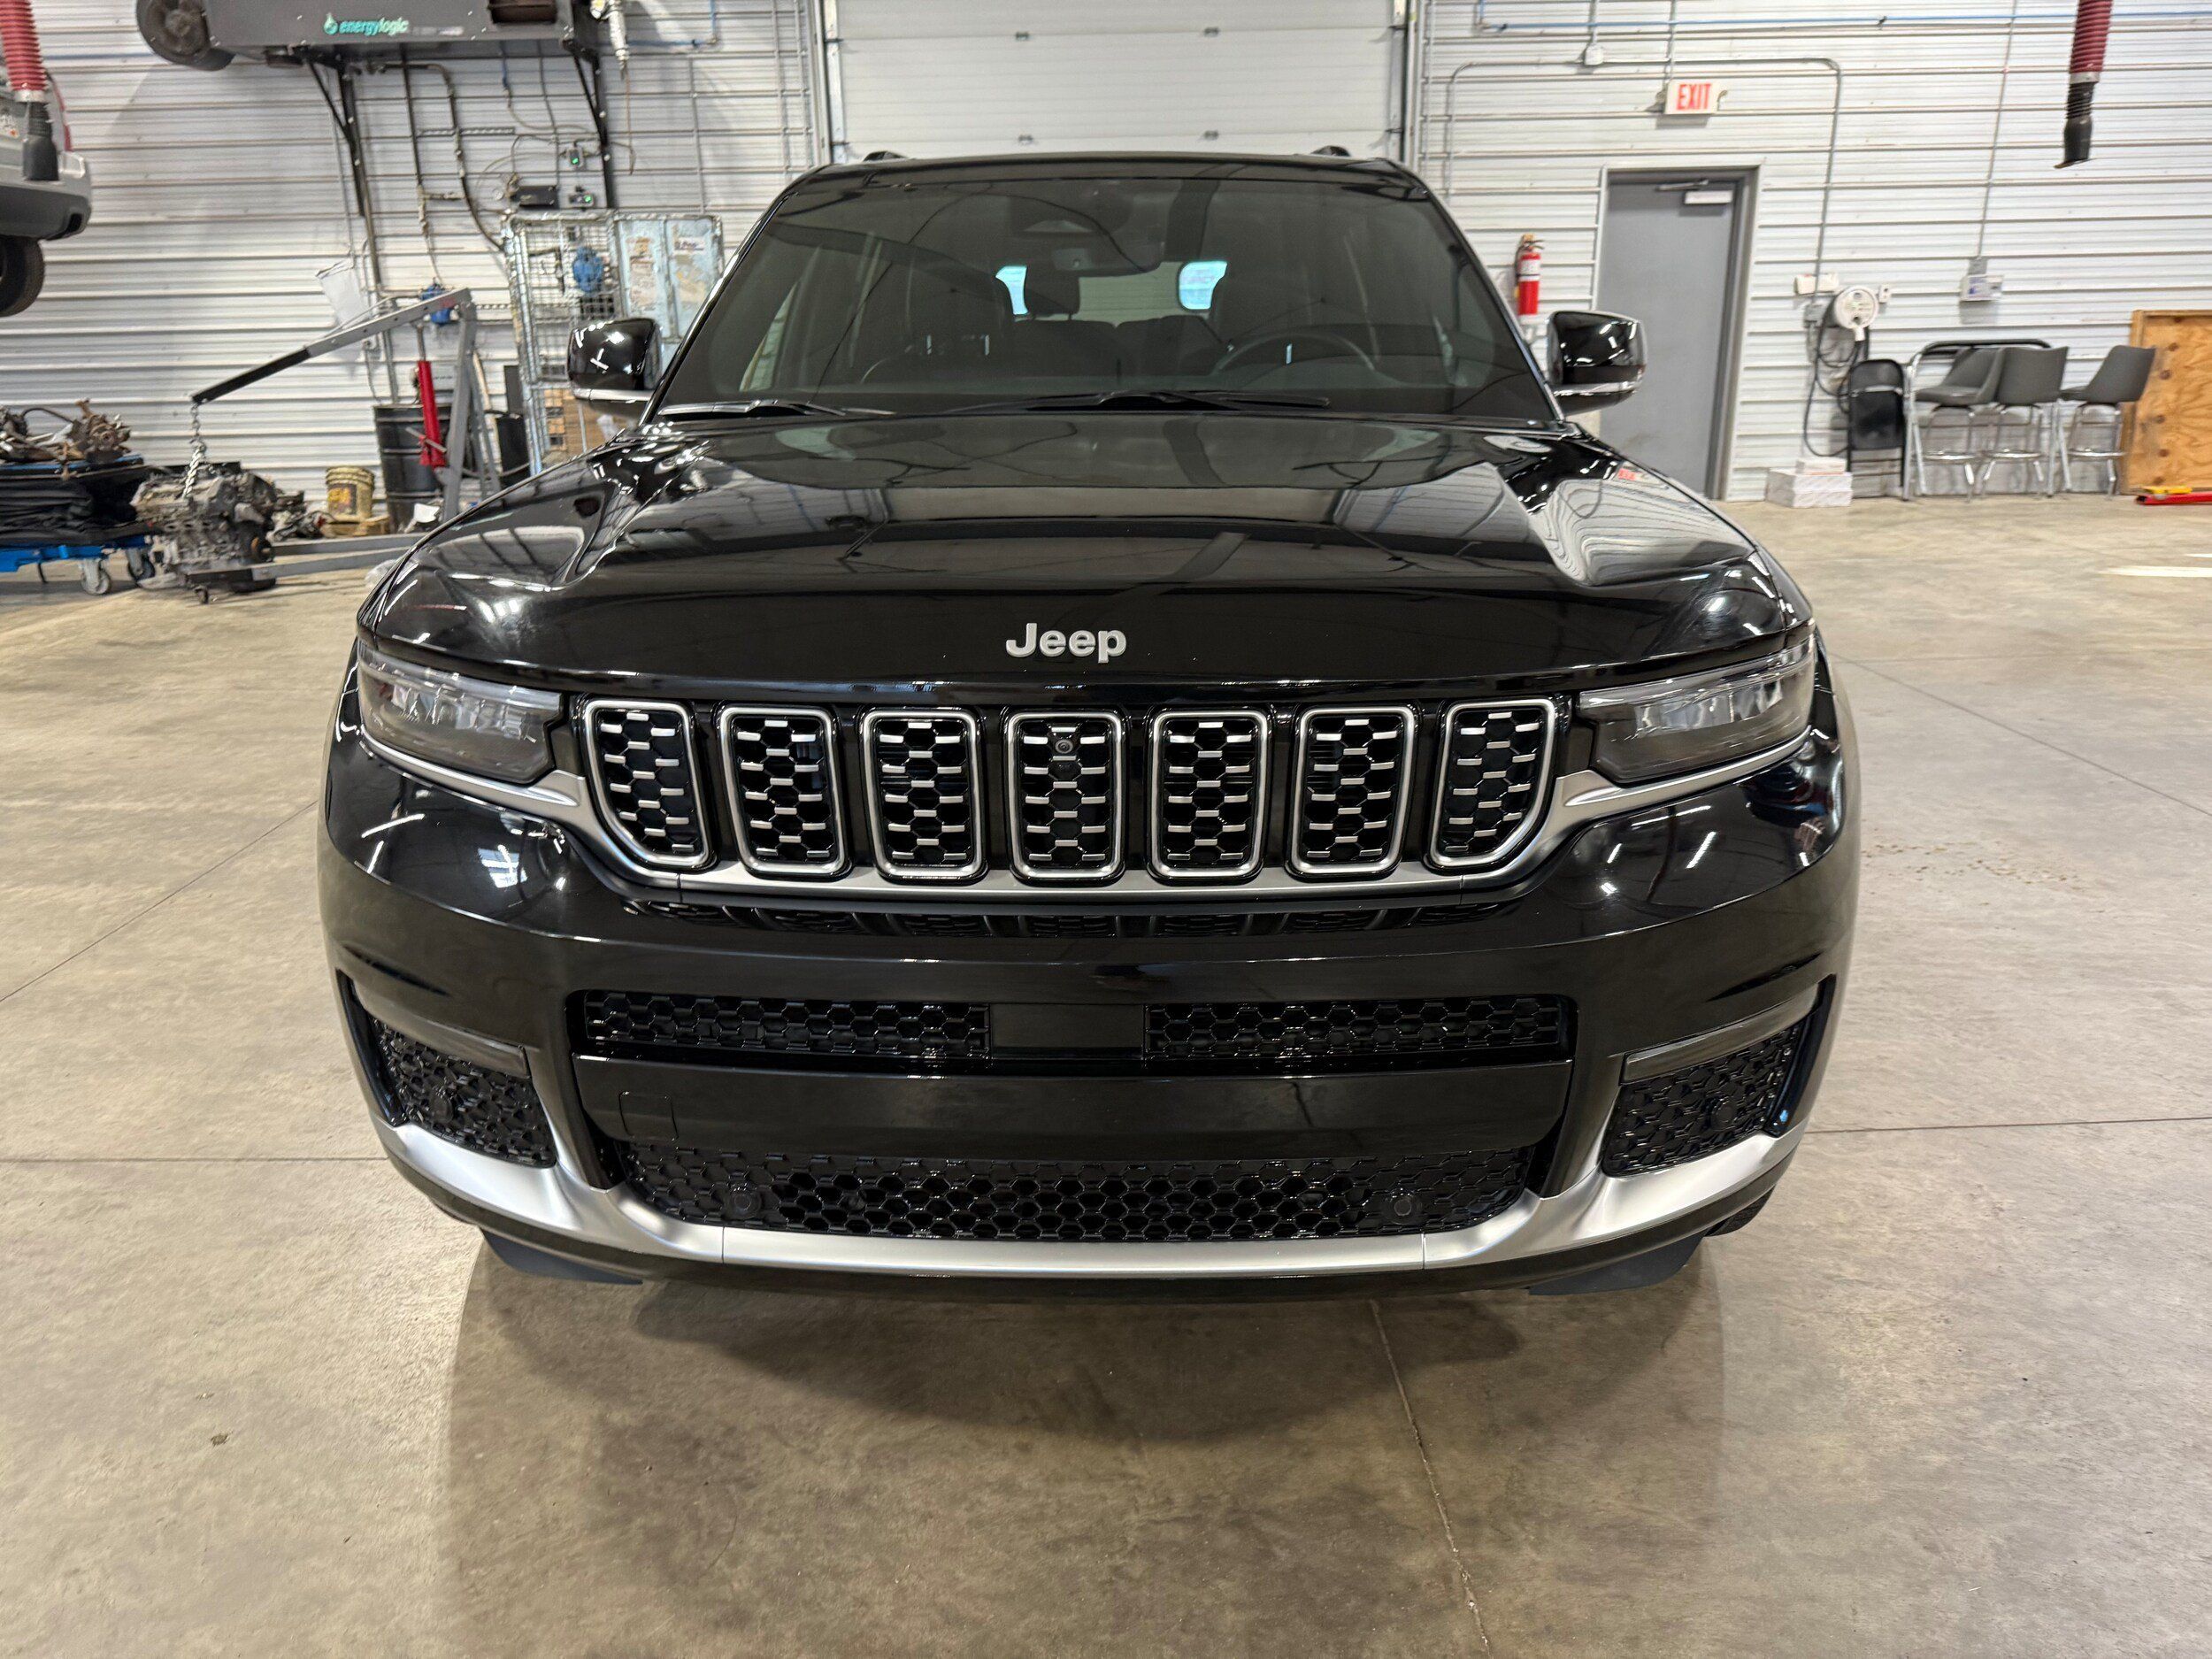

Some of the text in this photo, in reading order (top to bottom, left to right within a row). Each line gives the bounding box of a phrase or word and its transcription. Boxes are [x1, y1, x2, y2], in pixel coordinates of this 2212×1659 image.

[339, 18, 409, 36] energylogic
[1676, 83, 1711, 111] EXIT
[1005, 622, 1127, 664] Jeep
